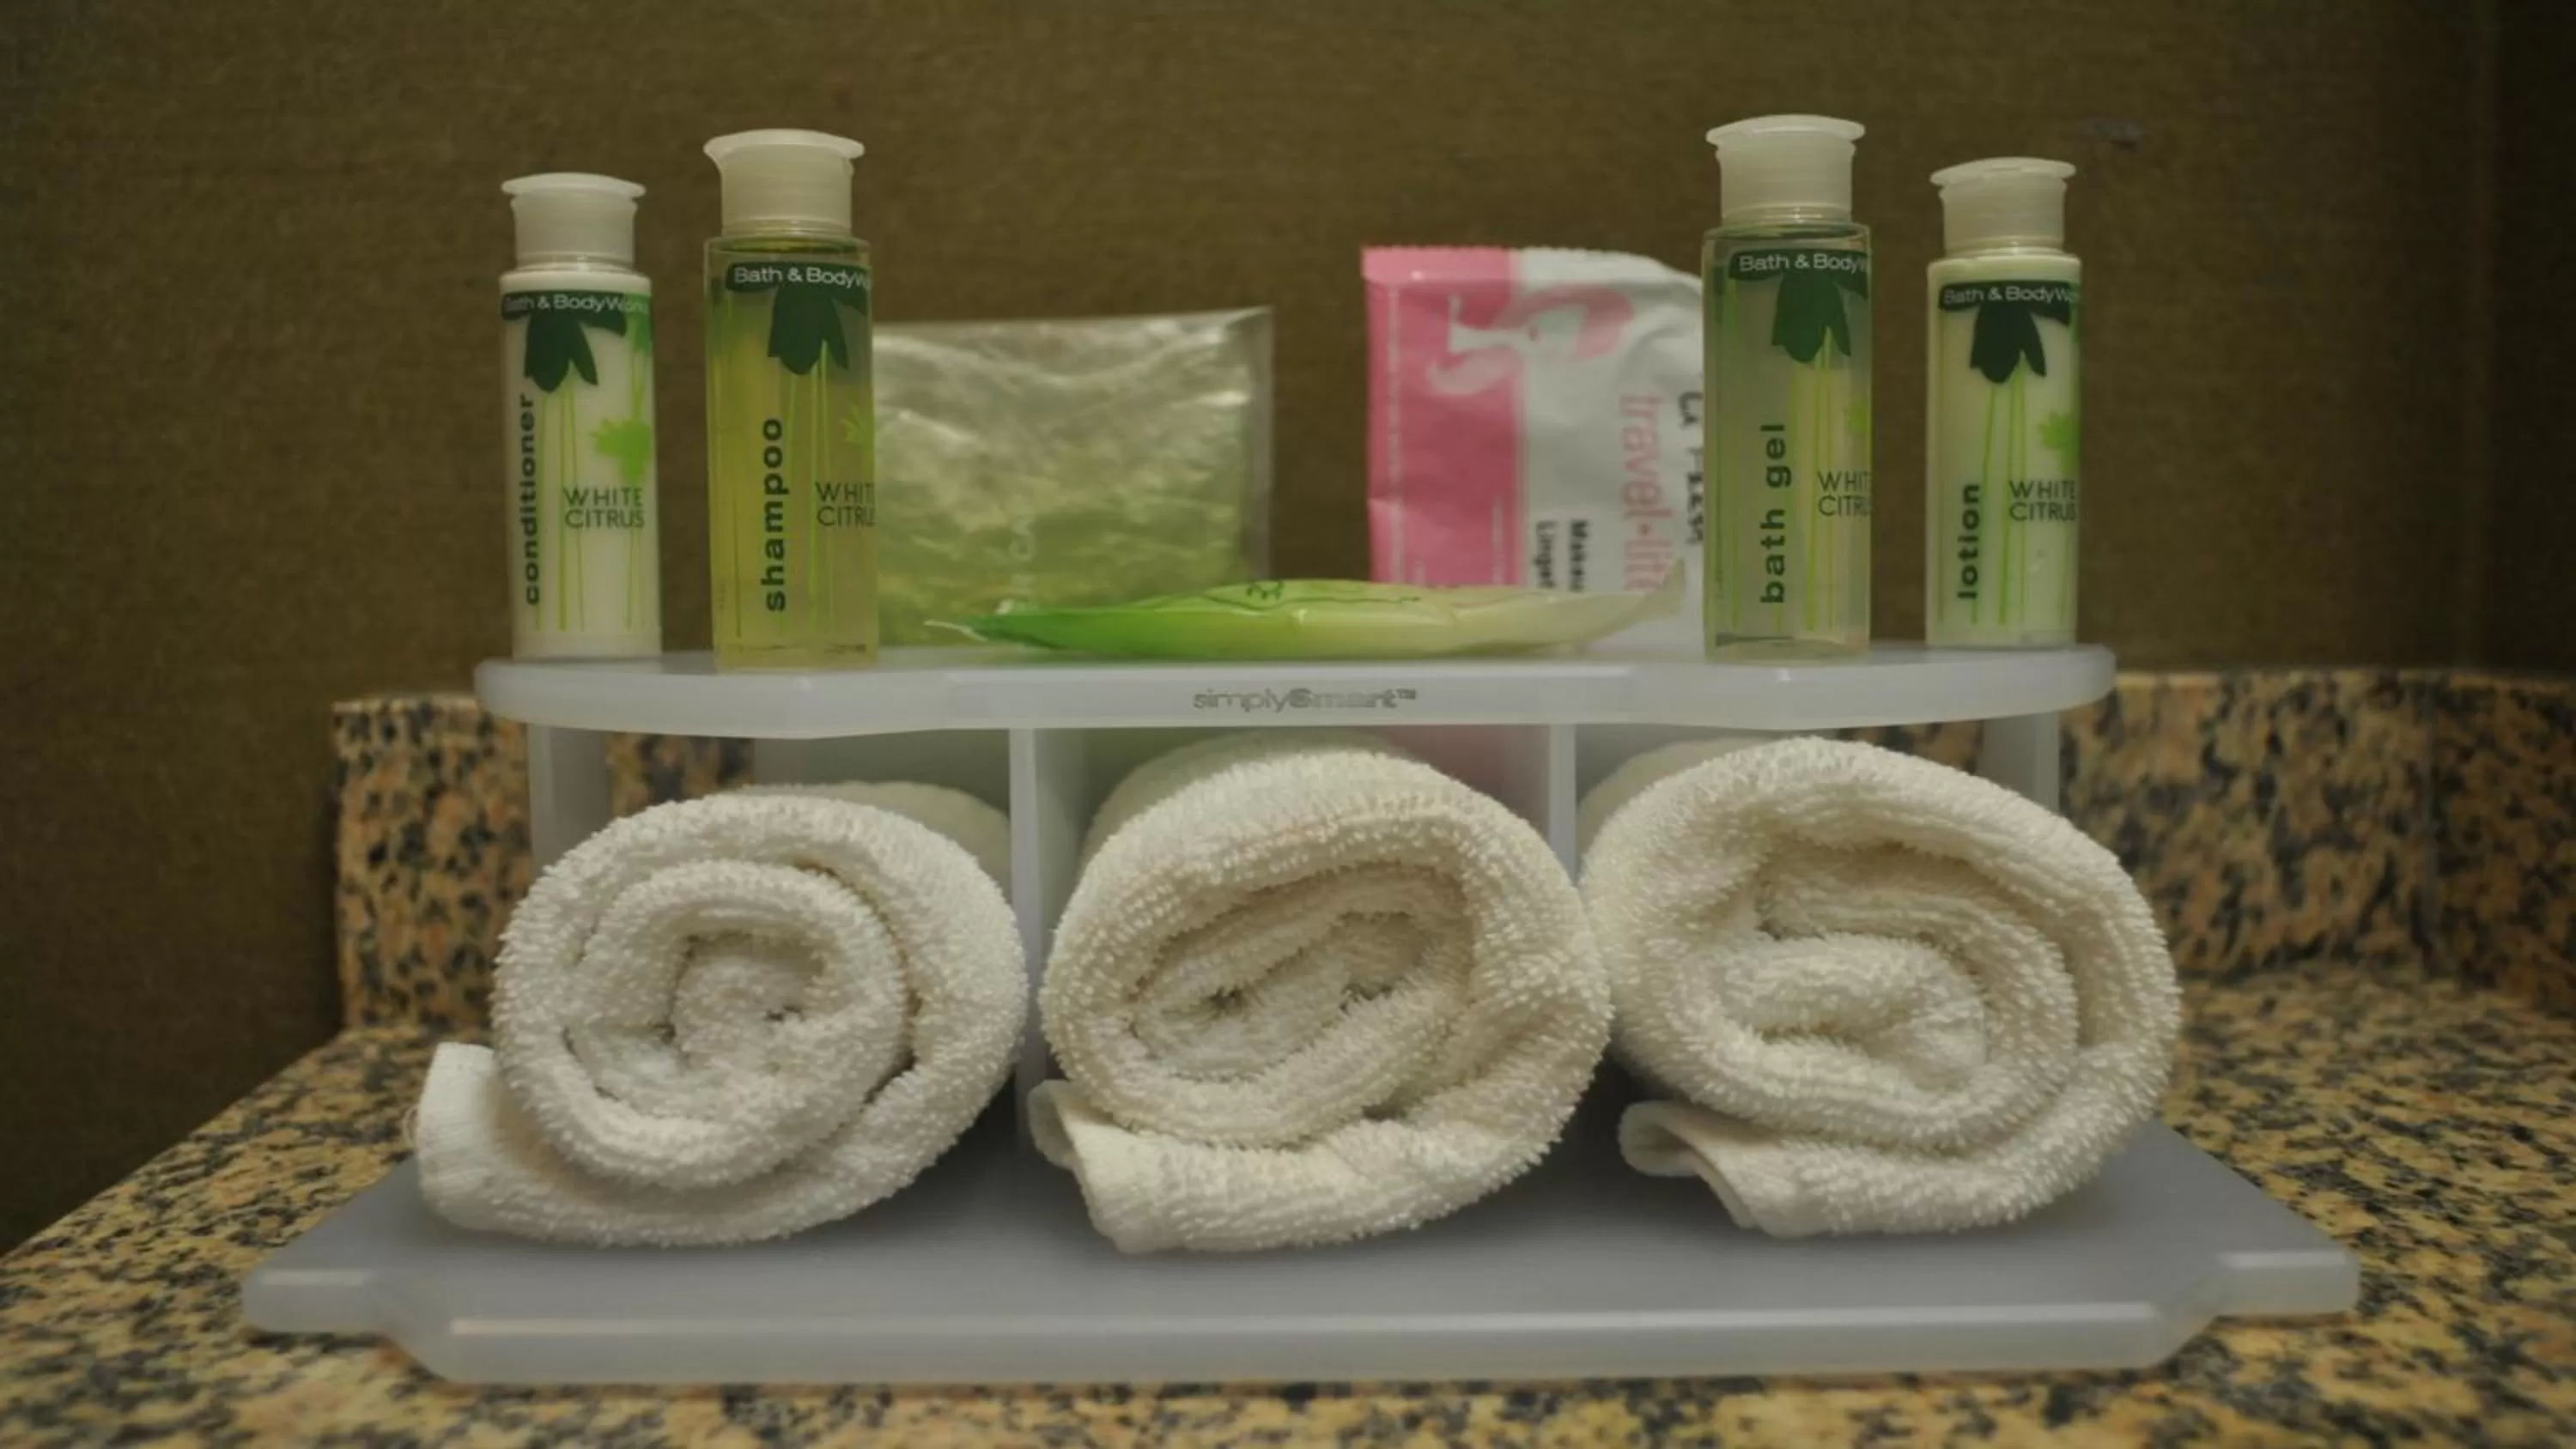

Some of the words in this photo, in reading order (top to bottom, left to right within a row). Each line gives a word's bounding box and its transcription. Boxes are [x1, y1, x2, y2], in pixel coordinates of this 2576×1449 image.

[1740, 255, 1789, 271] Bath
[1795, 254, 1810, 268] &
[734, 267, 782, 282] Bath
[788, 267, 802, 282] &
[538, 294, 551, 310] &
[1944, 287, 1984, 304] Bath
[1988, 288, 2002, 301] &
[1760, 424, 1791, 488] gel
[519, 394, 540, 605] conditioner
[563, 487, 644, 506] WHITE
[564, 509, 645, 528] CITRUS
[762, 419, 788, 613] shampoo
[1958, 484, 1981, 599] lotion
[1760, 509, 1785, 604] bath
